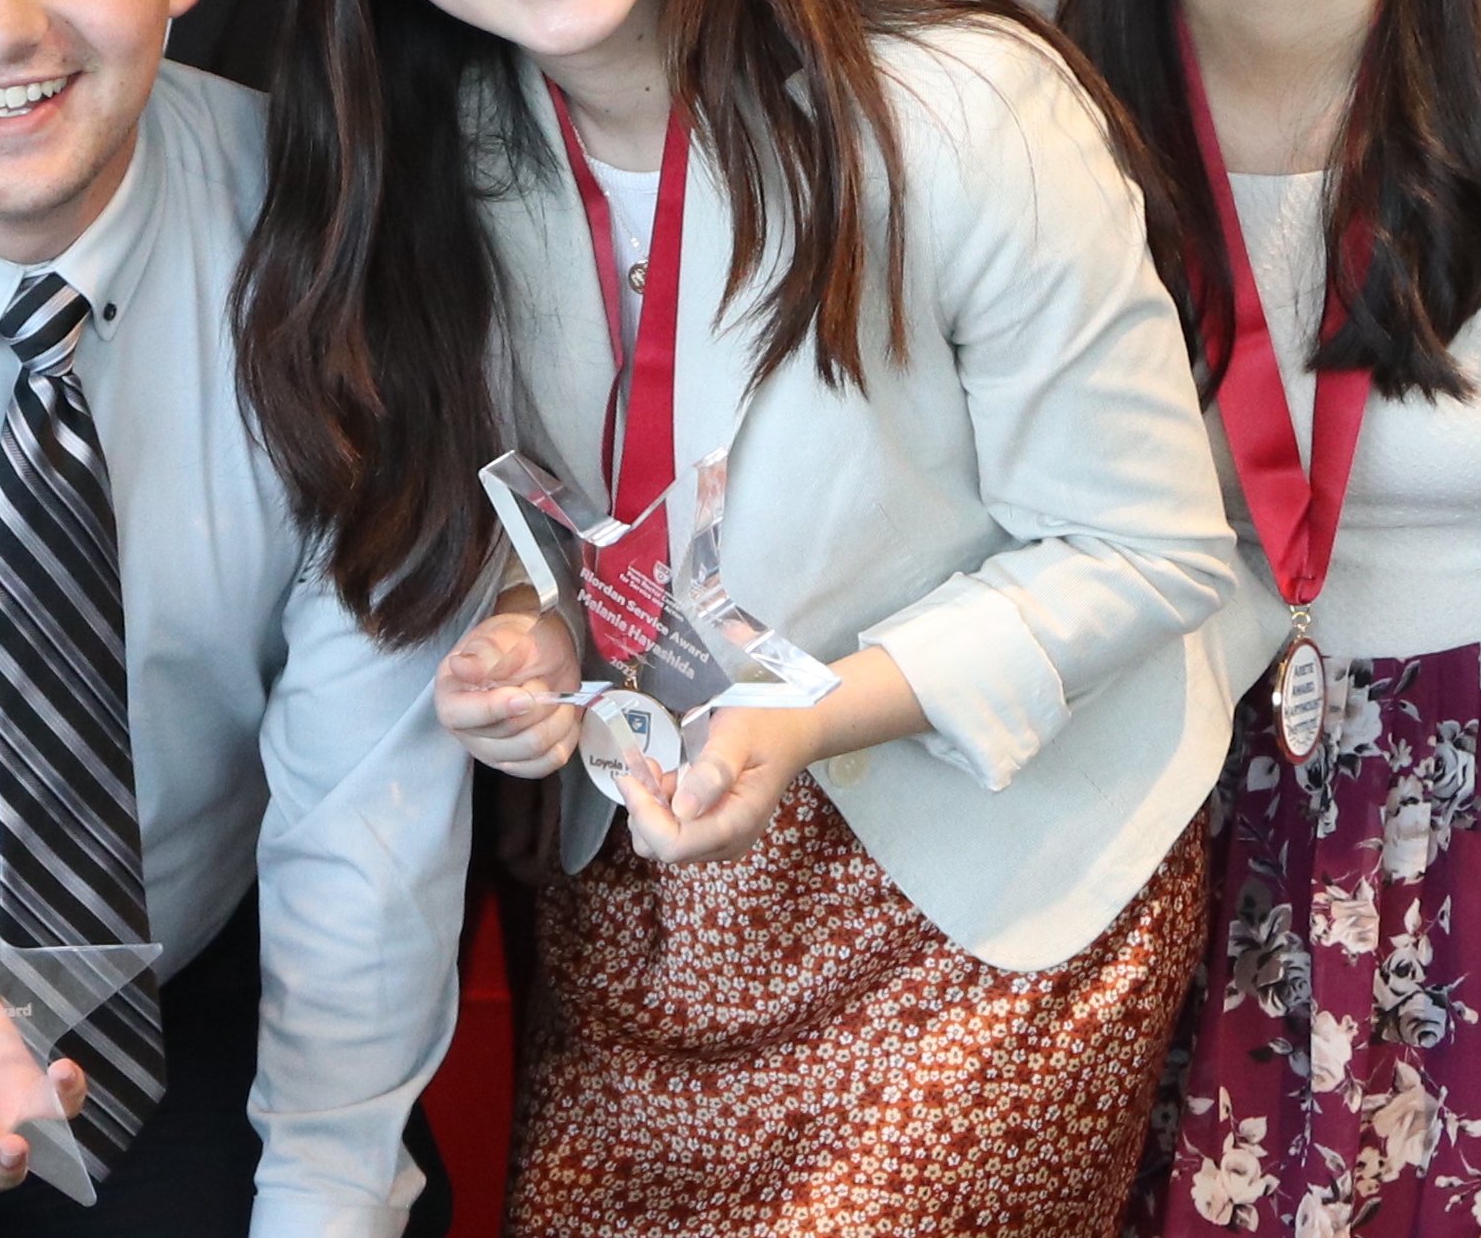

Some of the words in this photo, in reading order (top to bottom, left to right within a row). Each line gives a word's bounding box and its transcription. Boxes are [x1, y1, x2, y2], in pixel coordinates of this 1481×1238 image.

[577, 588, 628, 632] Melanie
[628, 624, 695, 680] Hayashida
[579, 567, 626, 606] Riordan
[626, 600, 669, 636] Service
[669, 631, 710, 663] Award
[610, 656, 637, 678] 2022
[589, 754, 623, 771] Loyola
